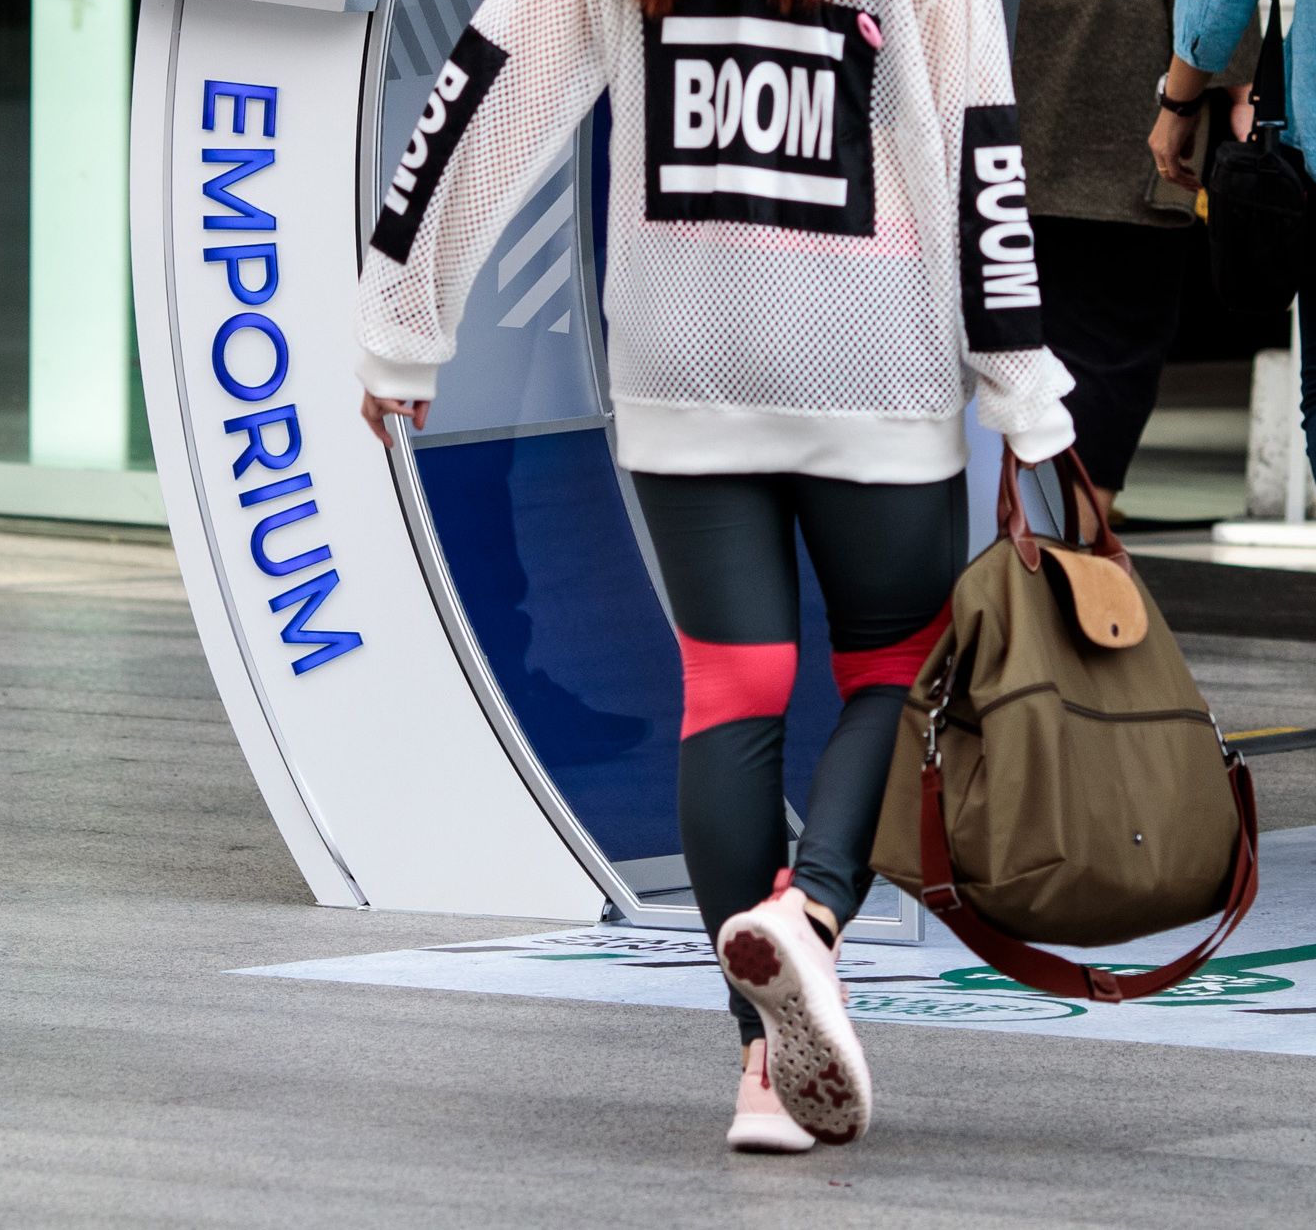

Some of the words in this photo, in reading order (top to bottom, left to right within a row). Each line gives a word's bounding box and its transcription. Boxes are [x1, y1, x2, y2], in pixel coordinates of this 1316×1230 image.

[383, 60, 470, 217] BOOM
[672, 57, 836, 161] BOOM
[202, 78, 364, 678] EMPORIUM
